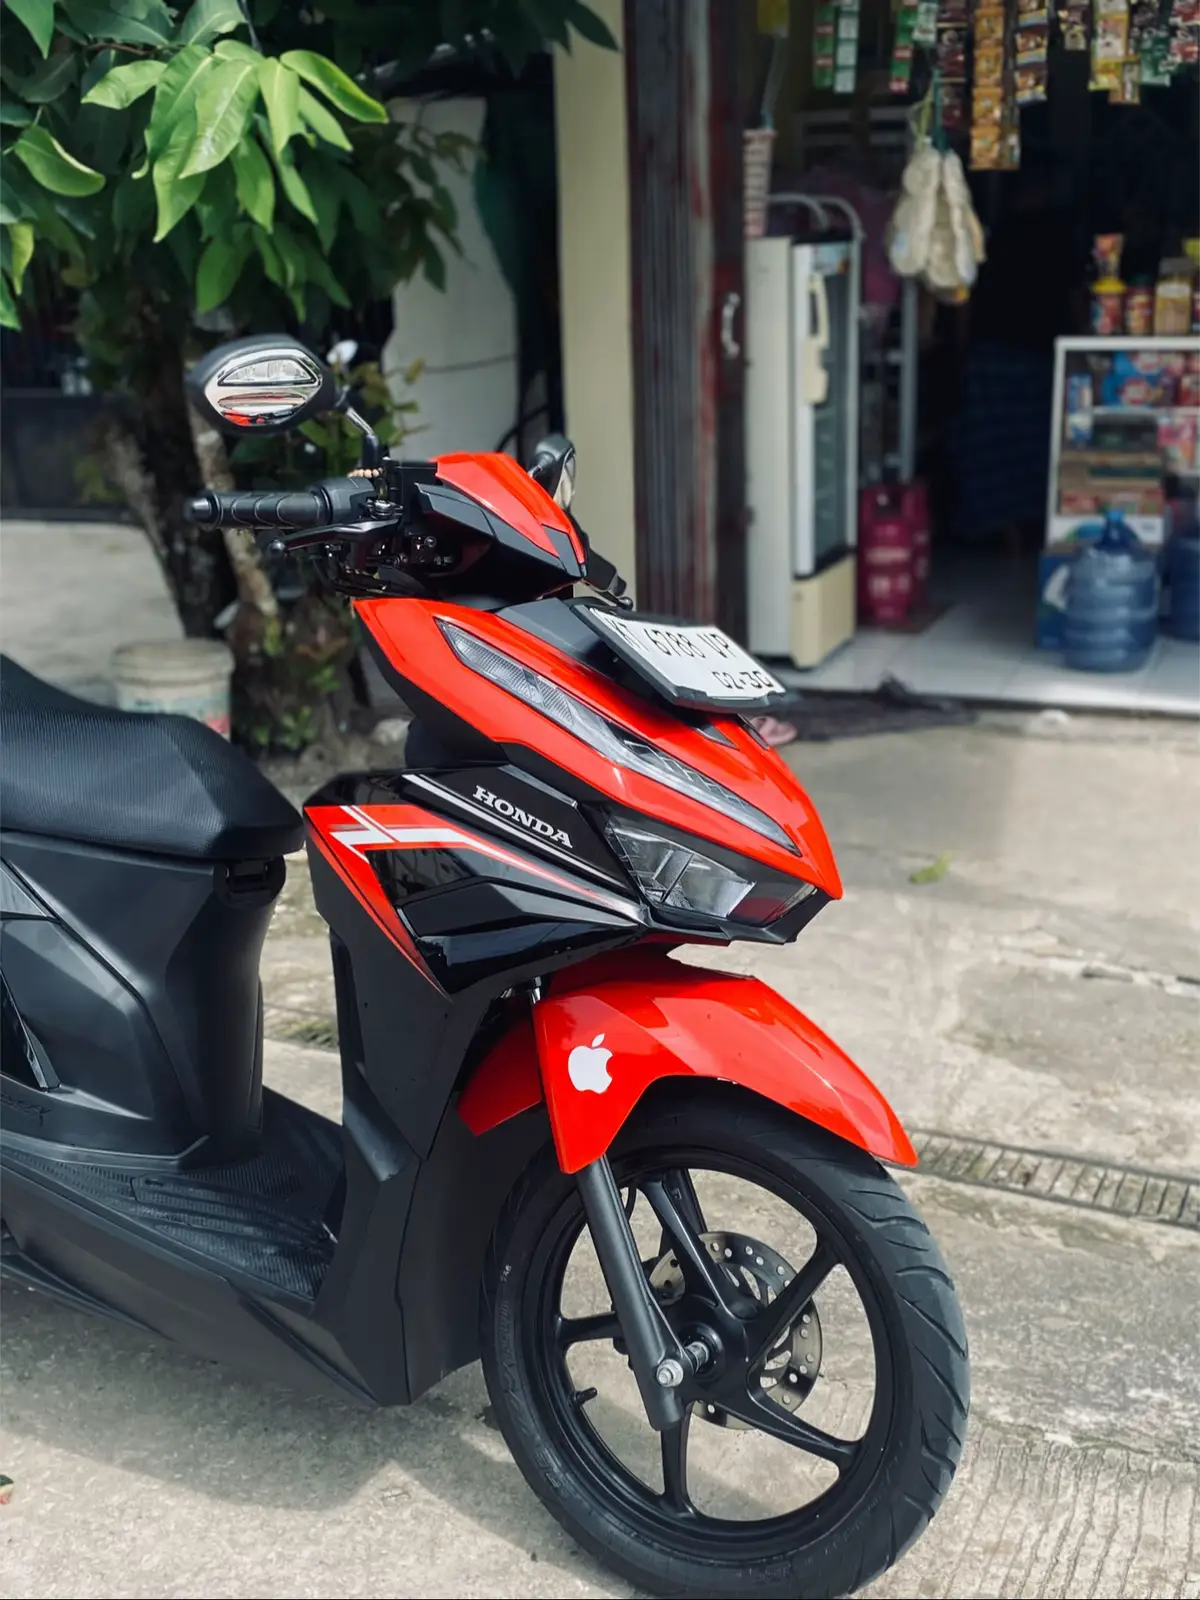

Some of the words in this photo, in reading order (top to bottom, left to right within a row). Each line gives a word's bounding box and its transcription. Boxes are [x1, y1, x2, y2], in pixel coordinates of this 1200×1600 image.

[643, 628, 706, 658] 6788
[696, 633, 736, 658] VP
[472, 785, 573, 848] HONDA
